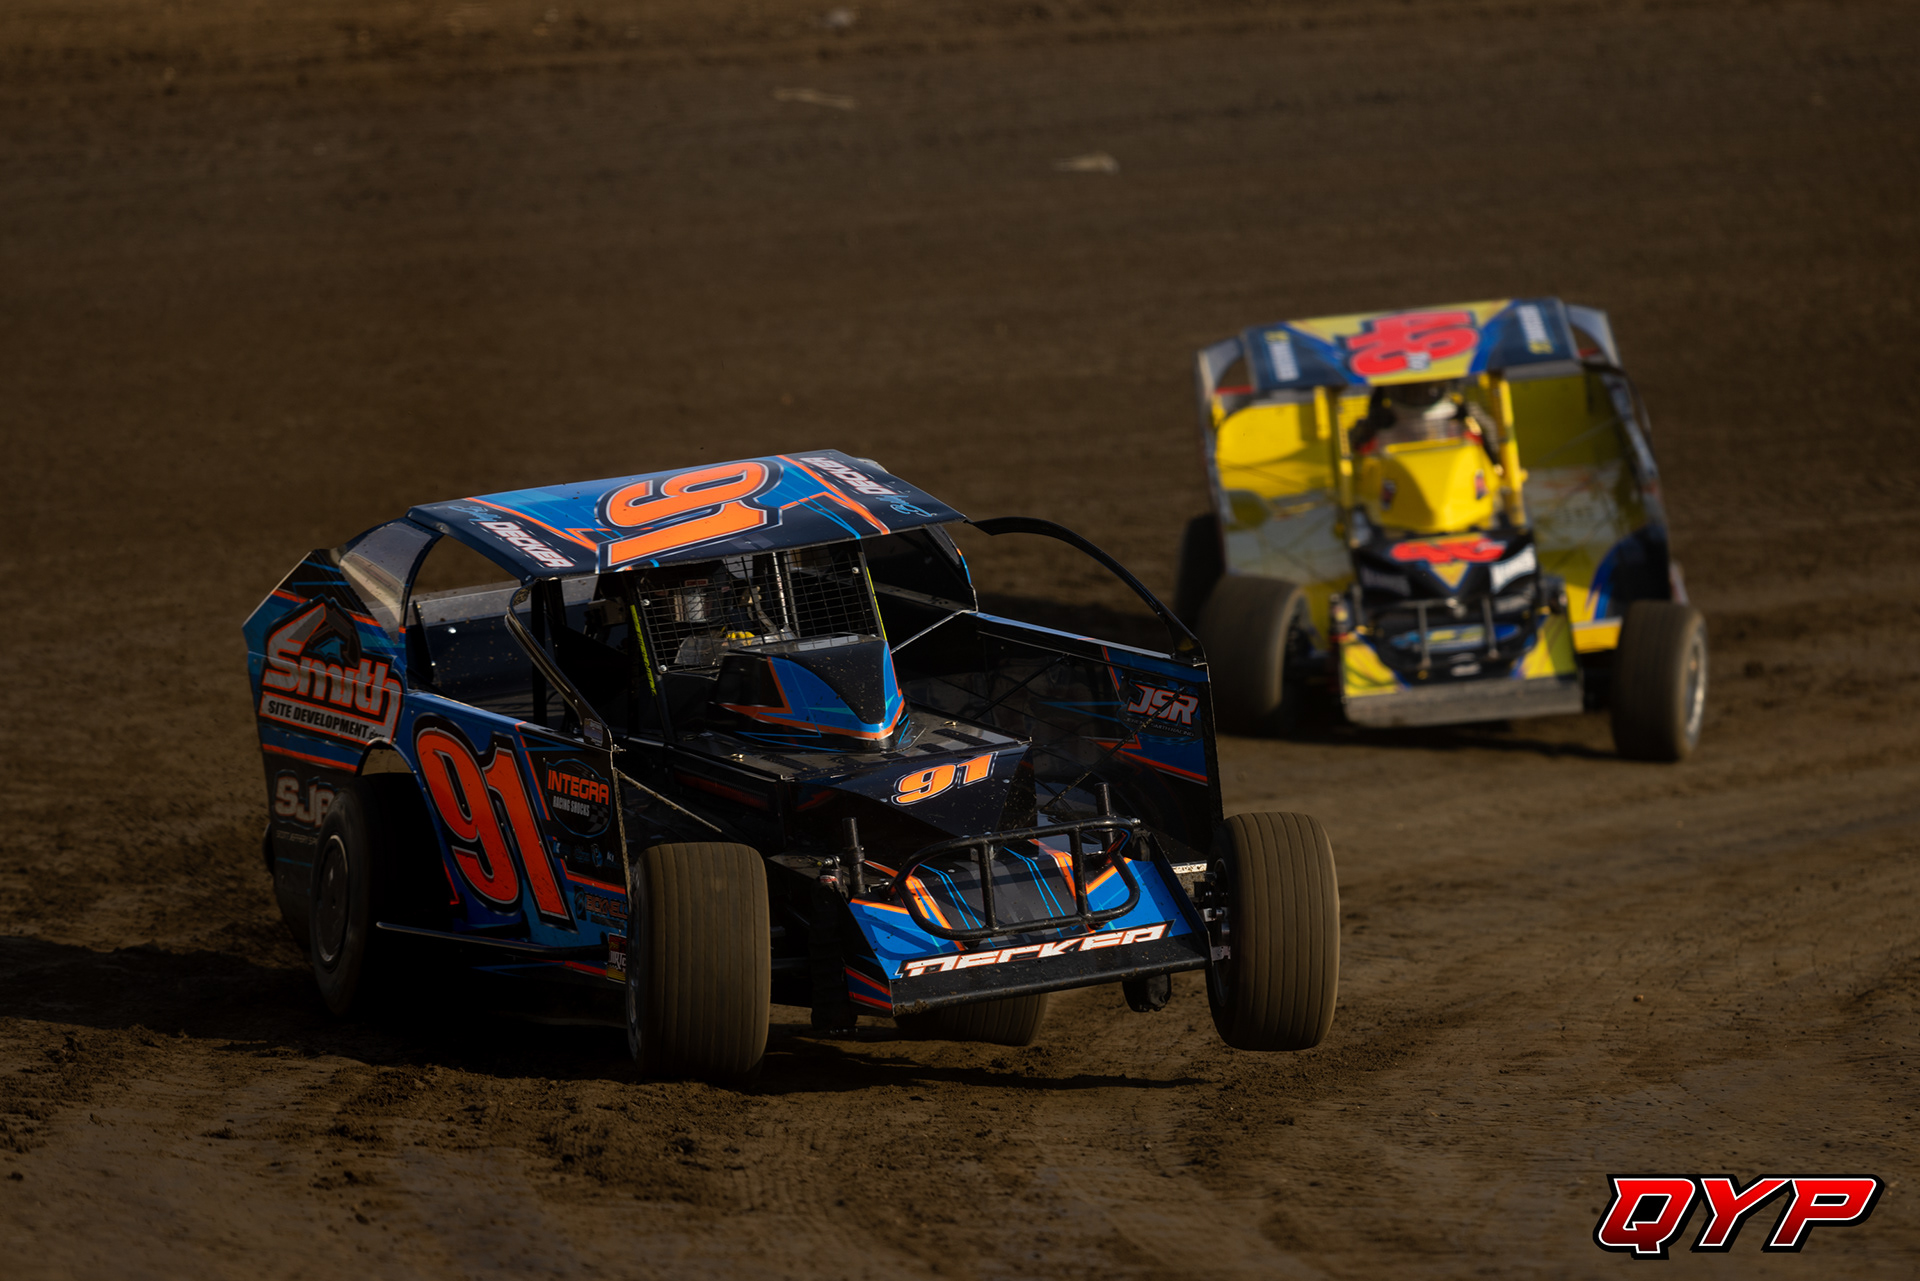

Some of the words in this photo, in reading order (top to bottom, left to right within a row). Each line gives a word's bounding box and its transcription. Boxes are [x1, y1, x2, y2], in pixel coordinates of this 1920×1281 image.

[604, 459, 773, 567] 91
[479, 520, 575, 568] DECKER
[262, 602, 402, 725] Smith
[269, 701, 293, 718] SITE
[1128, 683, 1198, 725] JSR
[547, 769, 609, 805] INTEGRA
[893, 753, 995, 804] 91
[415, 725, 572, 922] 91
